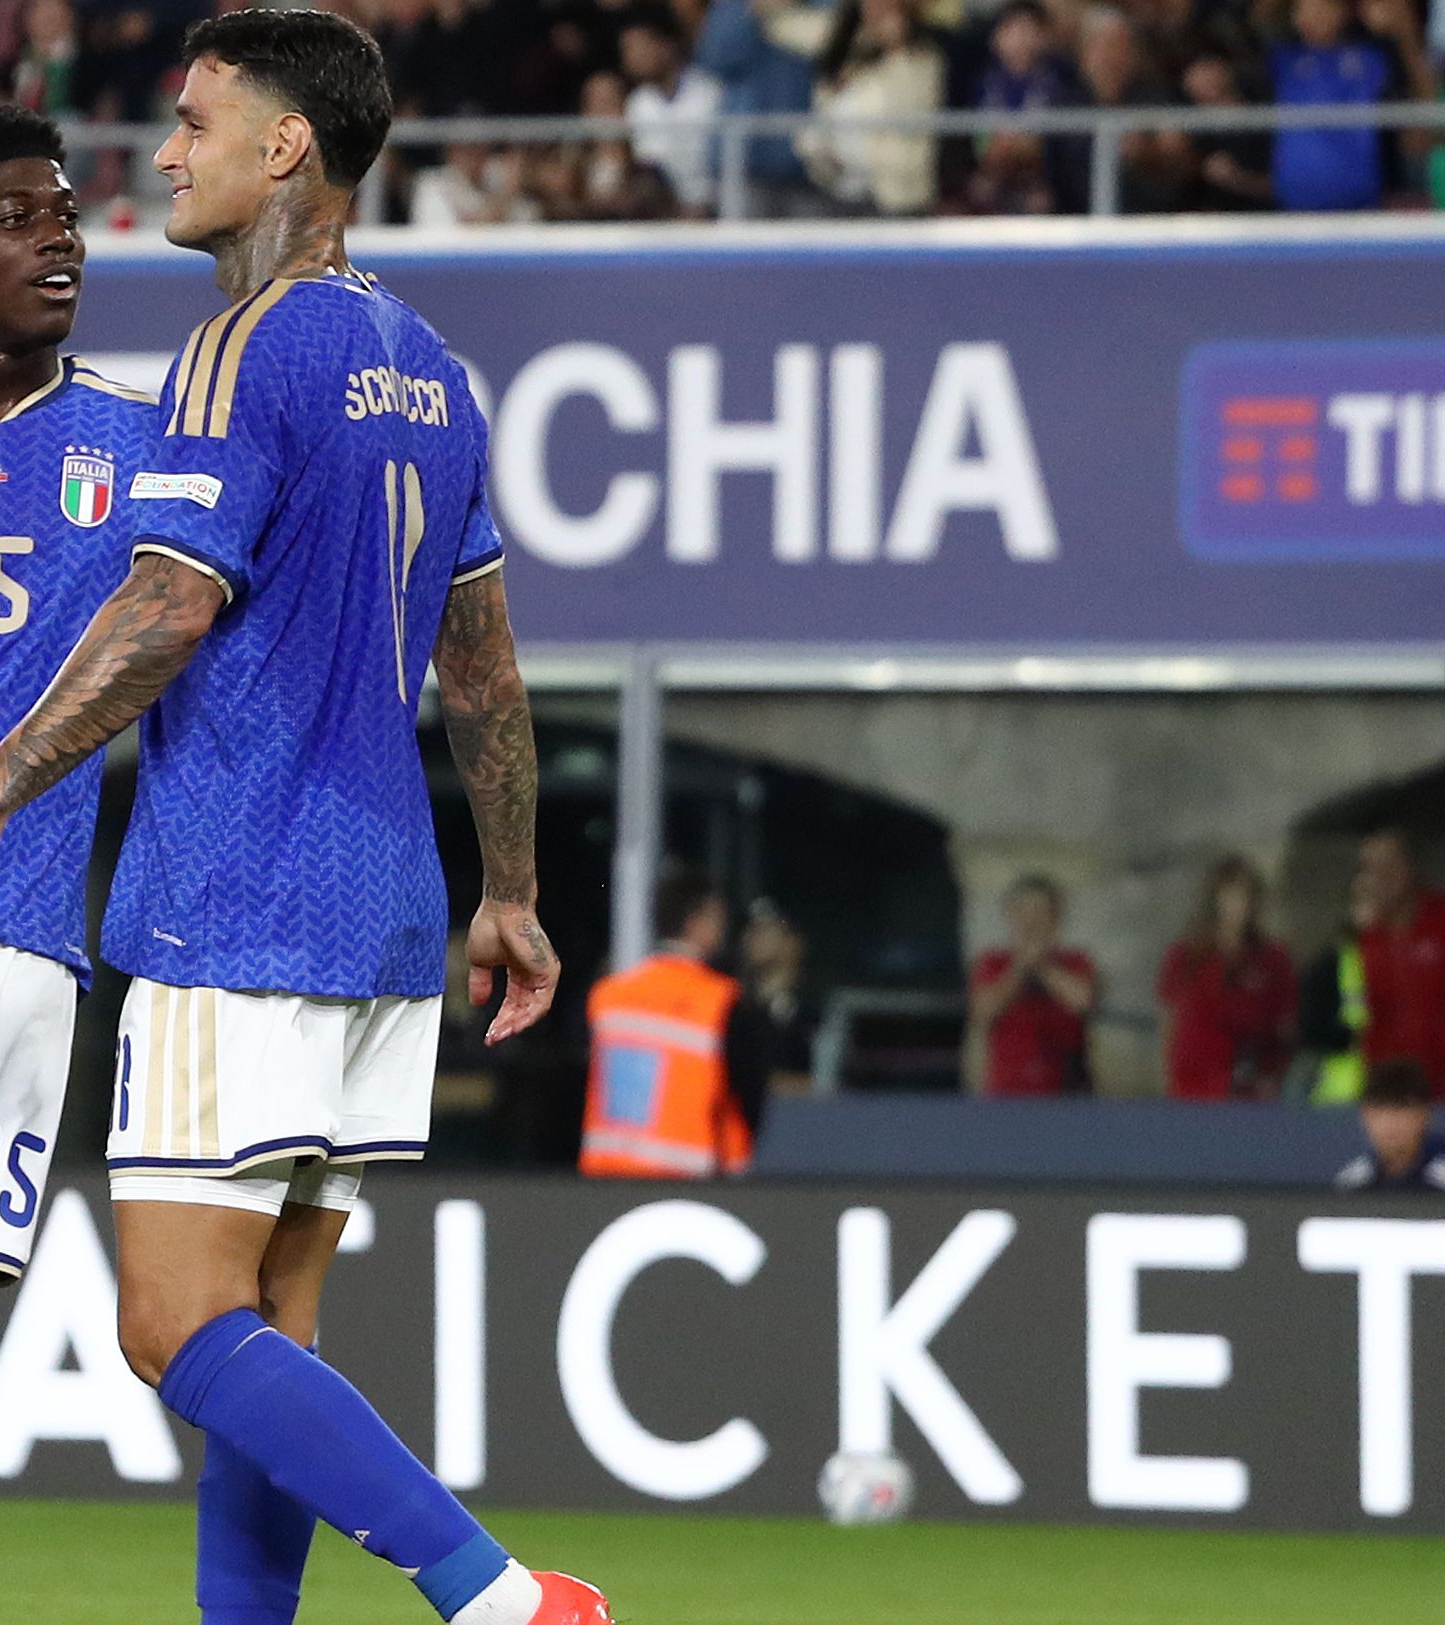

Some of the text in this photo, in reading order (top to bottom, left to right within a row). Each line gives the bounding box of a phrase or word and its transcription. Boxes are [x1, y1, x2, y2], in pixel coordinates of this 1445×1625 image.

[345, 365, 449, 427] SCACCA
[1328, 394, 1445, 503] TI
[67, 460, 109, 479] ITALIA
[134, 480, 217, 498] FOUNDATION
